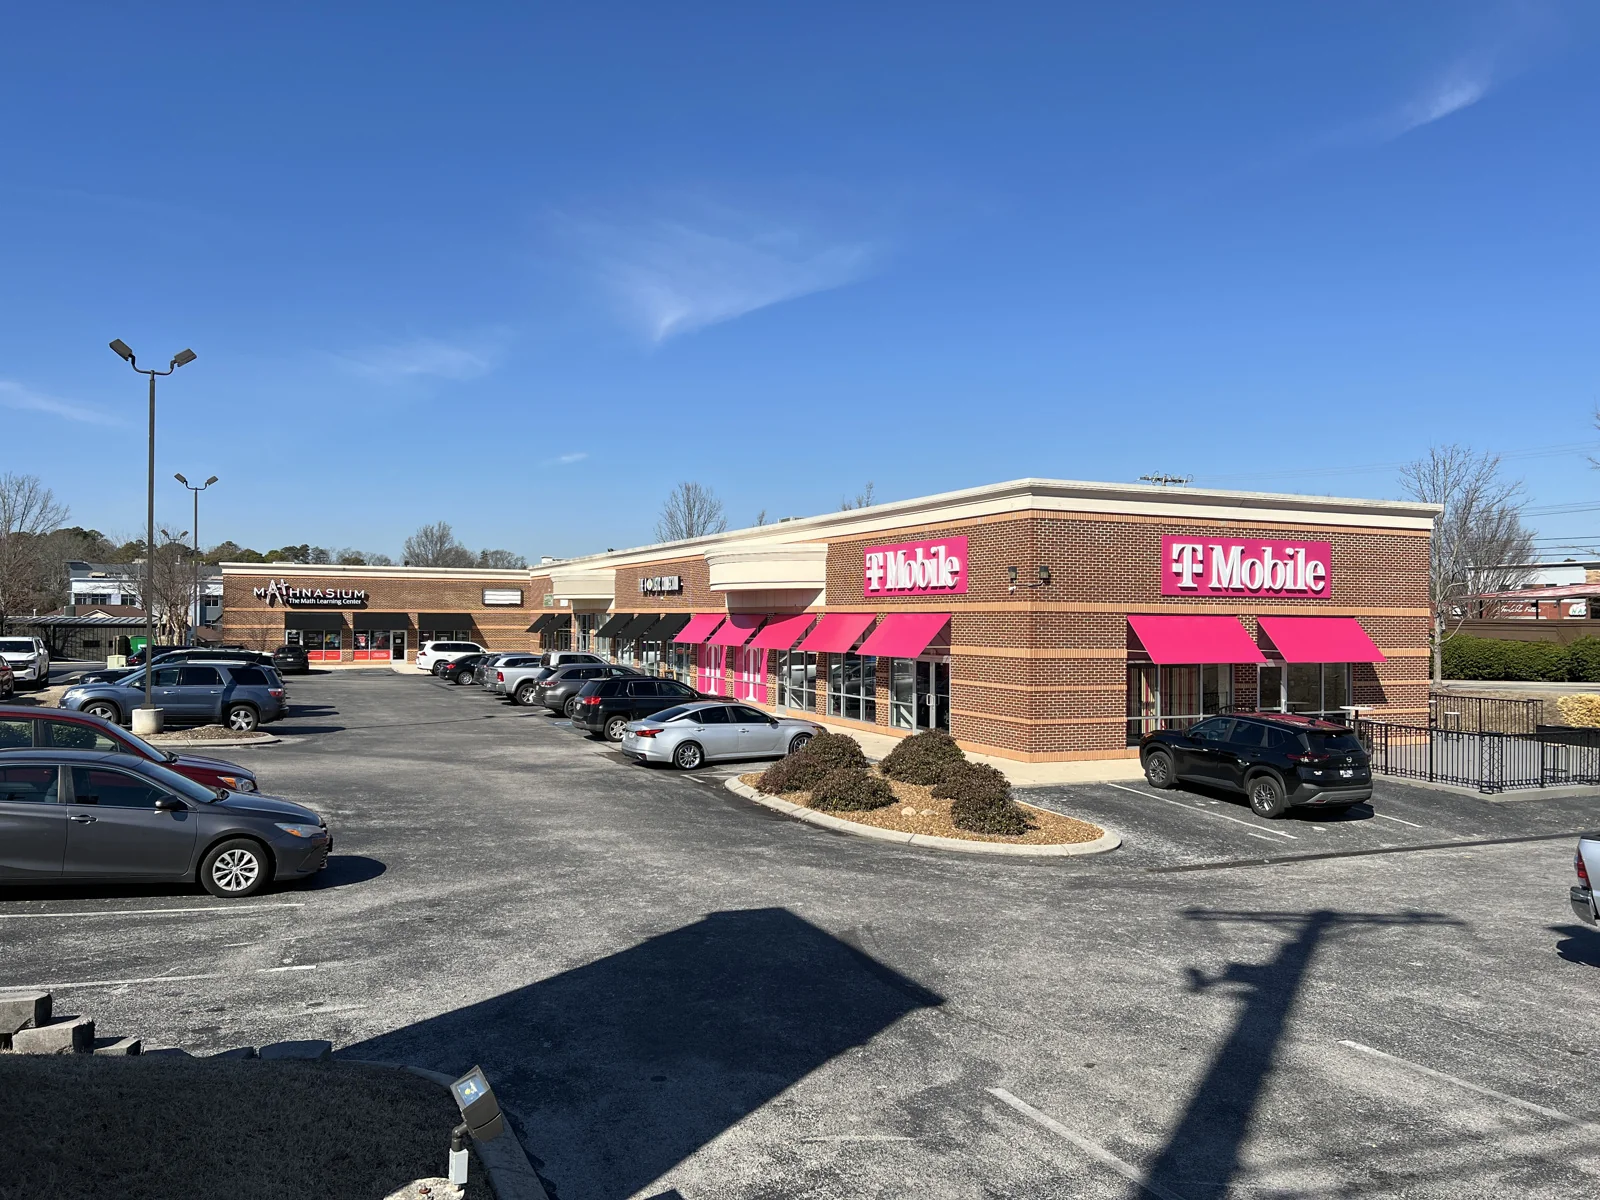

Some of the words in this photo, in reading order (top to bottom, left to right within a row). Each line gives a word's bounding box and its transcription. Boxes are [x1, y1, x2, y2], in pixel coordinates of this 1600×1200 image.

[865, 552, 884, 590] T
[884, 545, 960, 589] Mobile
[1172, 543, 1203, 587] T
[1208, 544, 1326, 591] Mobile
[316, 598, 342, 606] Learning
